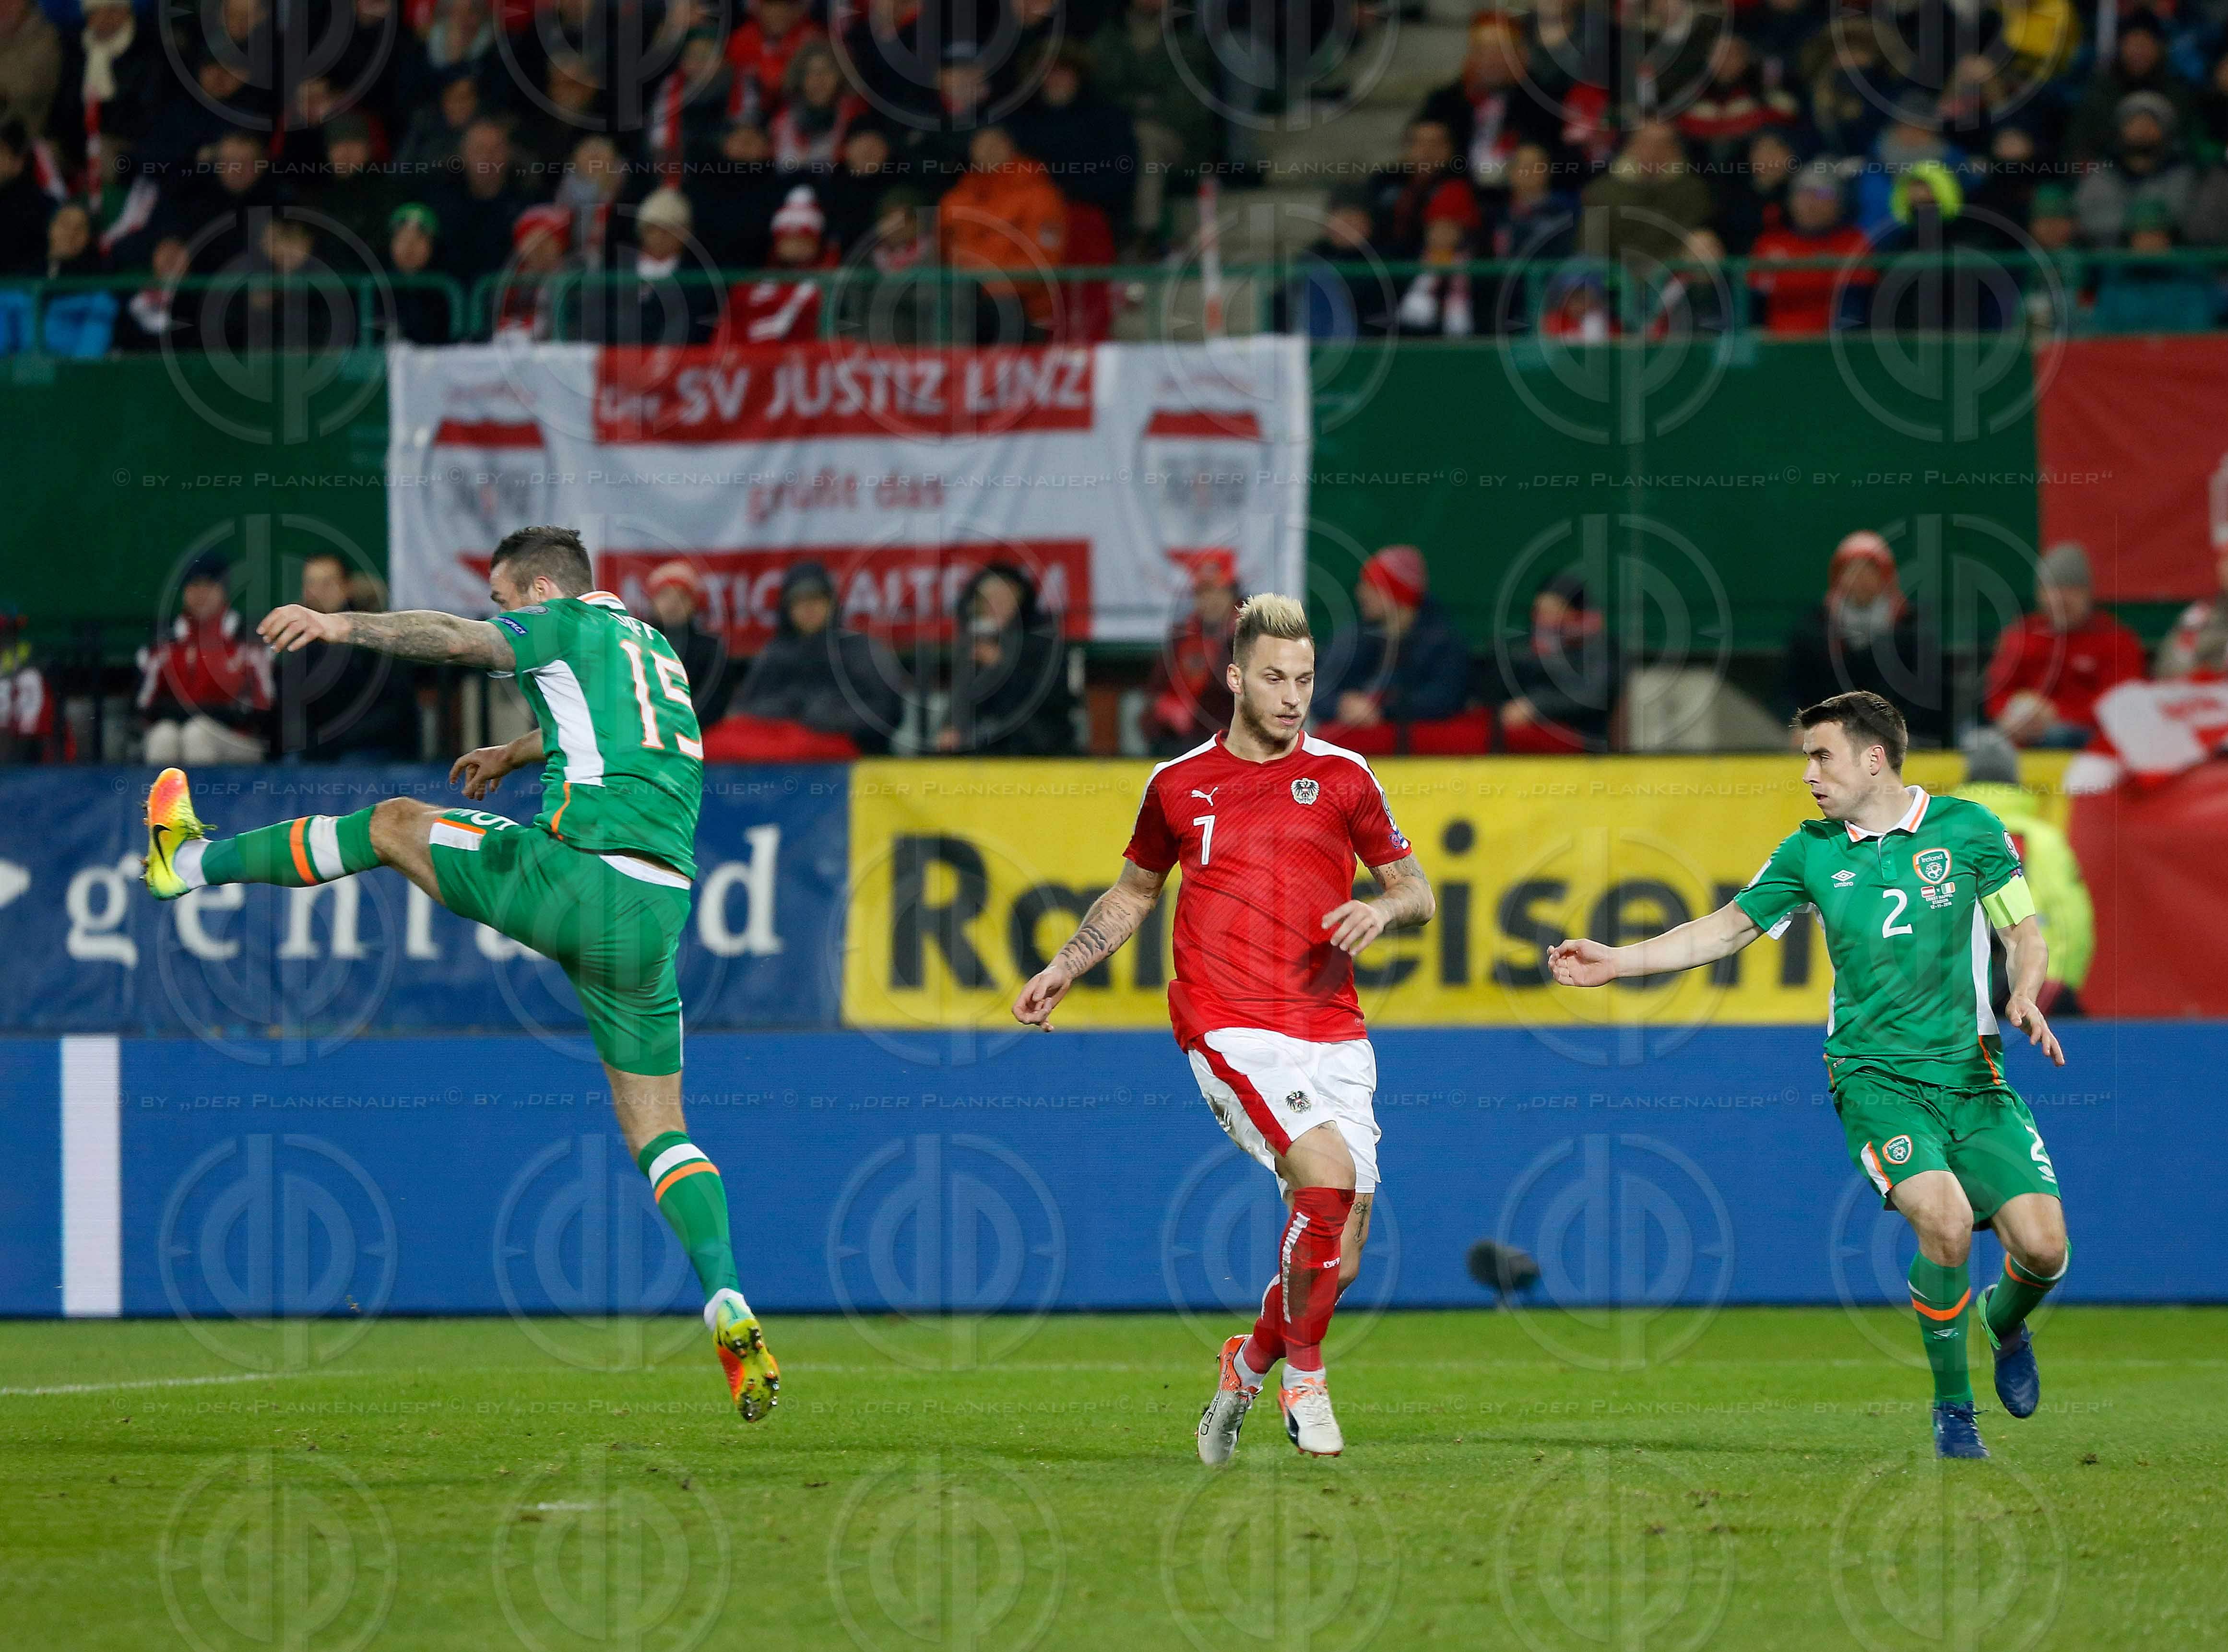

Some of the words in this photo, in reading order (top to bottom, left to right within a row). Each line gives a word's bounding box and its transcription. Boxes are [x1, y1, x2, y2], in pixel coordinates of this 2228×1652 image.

[676, 367, 752, 425] SV
[963, 348, 1086, 413] LINZ
[620, 639, 704, 760] 15
[1193, 814, 1216, 865] 7
[1920, 853, 1944, 863] Ireland
[1882, 888, 1913, 939] 2
[2024, 1124, 2052, 1168] 2
